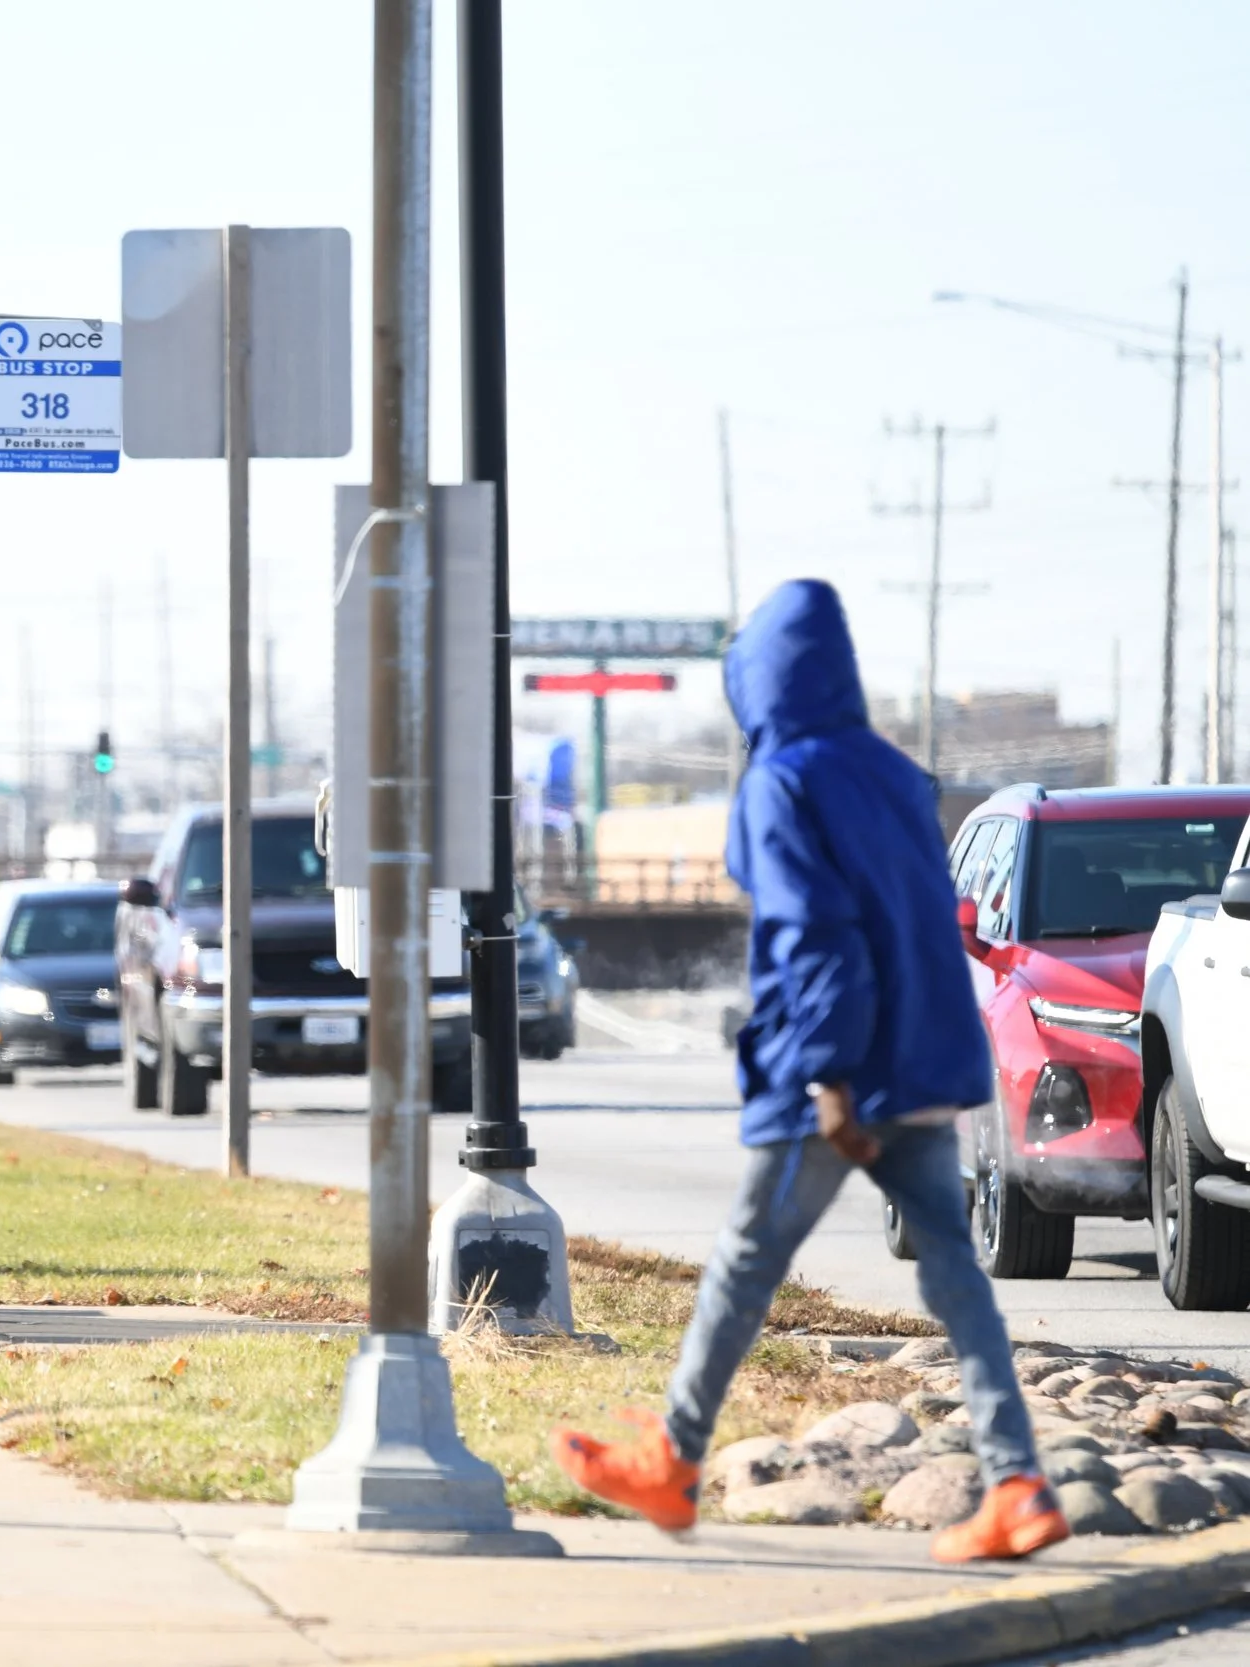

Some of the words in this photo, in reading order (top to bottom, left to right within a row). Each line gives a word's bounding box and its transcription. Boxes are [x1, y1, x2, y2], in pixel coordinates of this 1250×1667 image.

[39, 332, 103, 351] pace
[43, 362, 93, 375] STOP
[21, 392, 70, 419] 318
[5, 438, 86, 449] PaceBus.com
